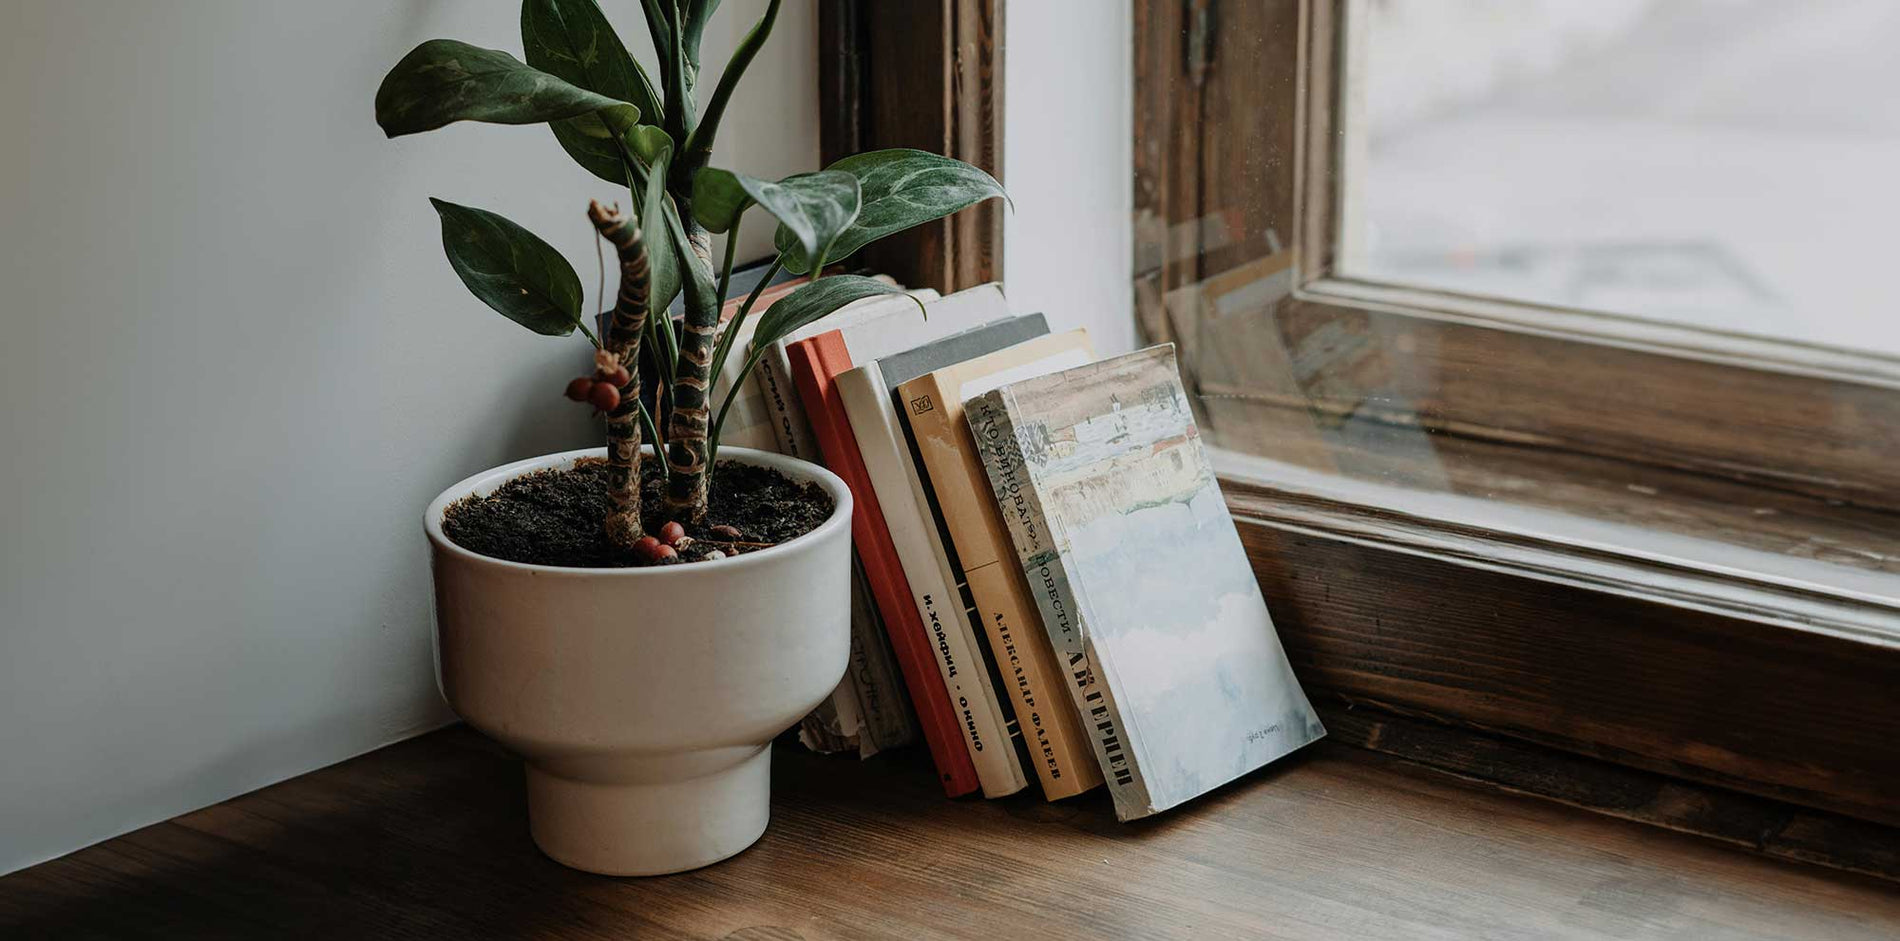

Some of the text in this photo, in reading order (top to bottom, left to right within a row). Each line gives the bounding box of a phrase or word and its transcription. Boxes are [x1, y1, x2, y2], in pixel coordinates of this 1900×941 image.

[762, 359, 799, 457] ЮРИЙ ОЛЕ
[980, 404, 999, 439] КТО
[1036, 554, 1071, 634] ПОВЕСТИ
[1086, 691, 1134, 787] ГЕРЦЕН
[993, 612, 1061, 780] АЛЕКСАНДР ФАДЕЕВ
